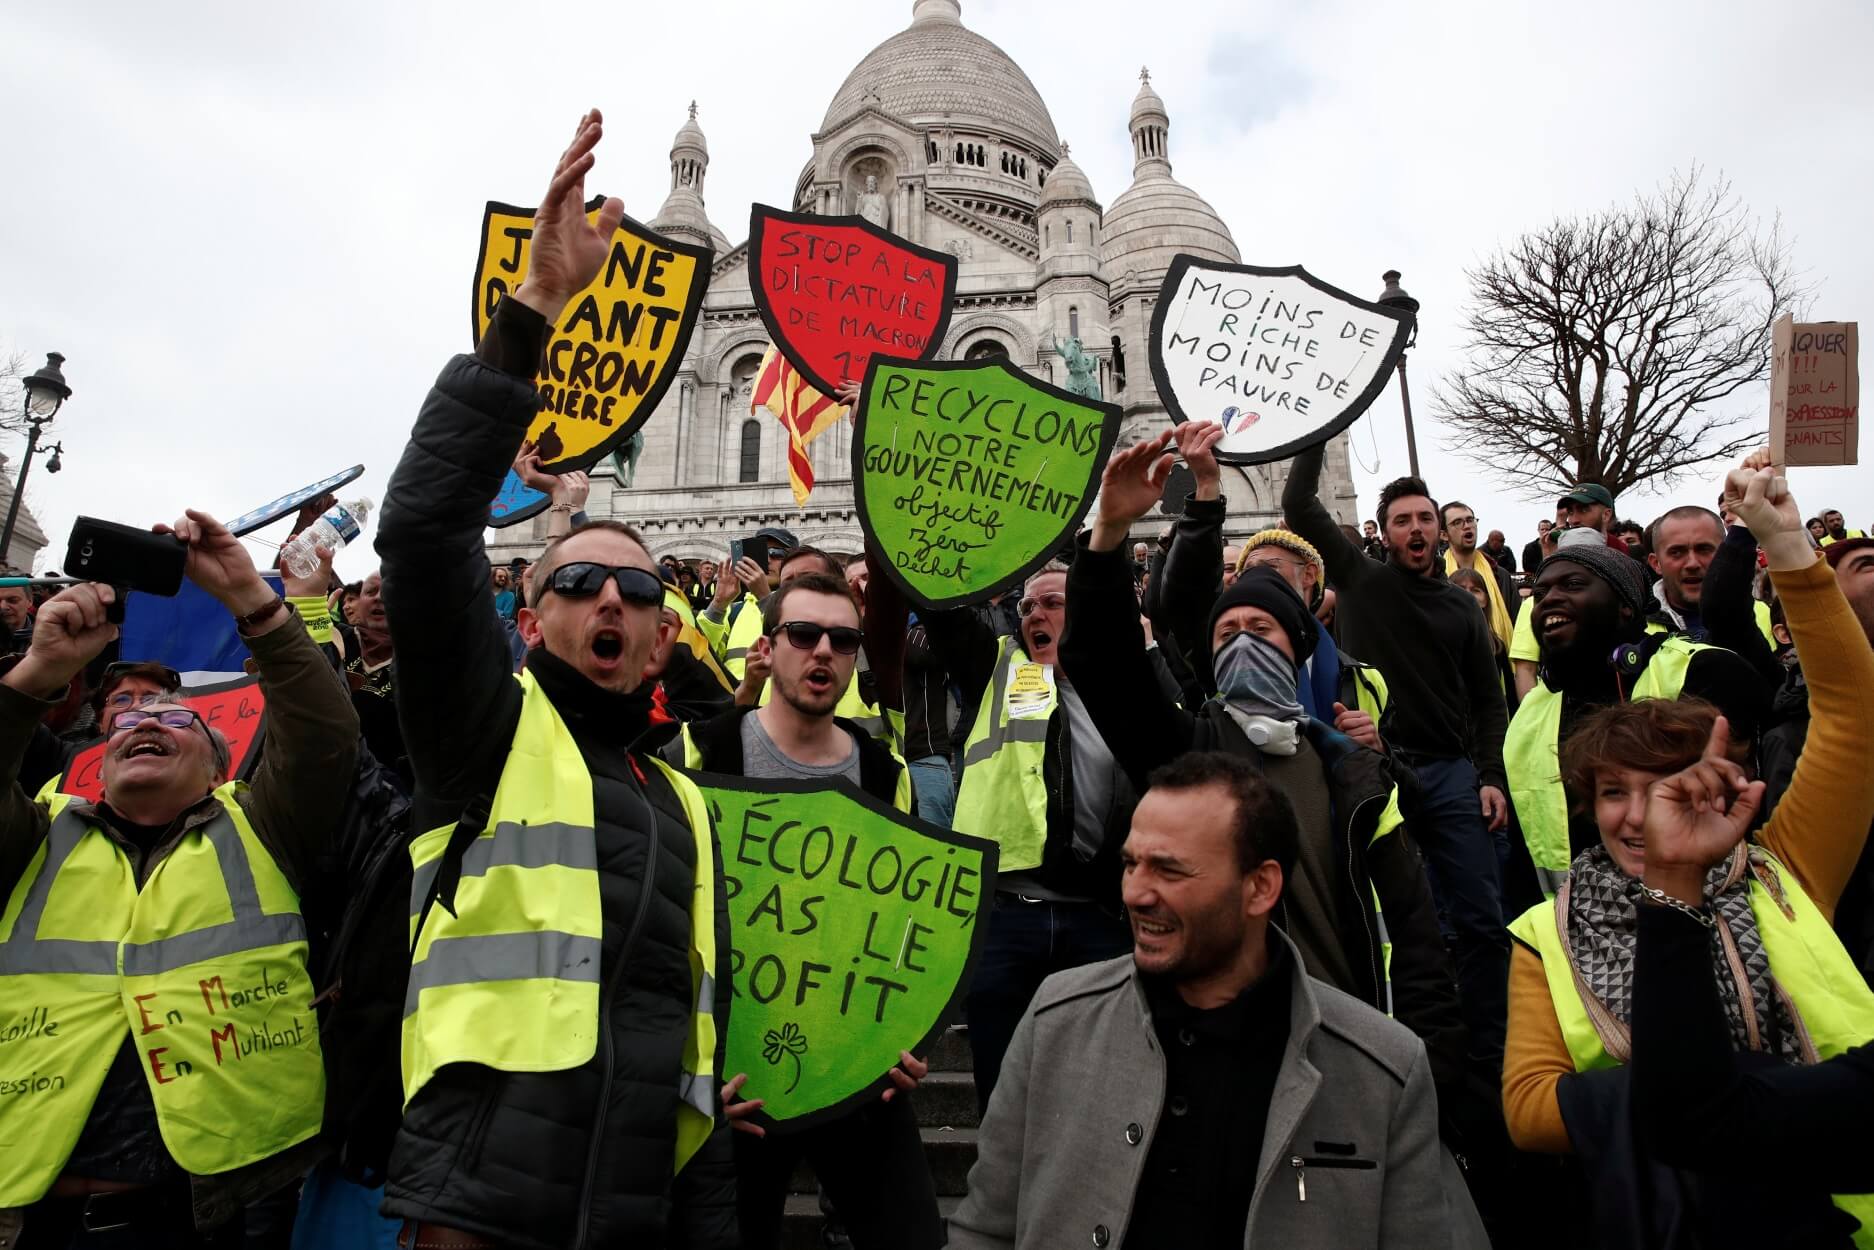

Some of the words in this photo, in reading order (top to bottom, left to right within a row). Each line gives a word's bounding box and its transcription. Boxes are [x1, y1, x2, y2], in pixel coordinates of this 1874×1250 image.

[499, 227, 675, 297] JNE
[777, 231, 862, 266] STOP
[872, 251, 890, 276] A
[904, 258, 936, 289] LA
[788, 307, 821, 332] DE
[840, 315, 928, 350] MACRON
[1340, 321, 1380, 347] DE
[1199, 367, 1311, 416] PAUVRE
[1316, 372, 1350, 400] DE
[1819, 380, 1838, 394] LA
[881, 374, 1104, 457] RECYCLONS
[913, 430, 1021, 468] NOTRE
[863, 445, 1080, 520] GOUVERNEMENT
[894, 485, 1004, 540] objectif
[863, 911, 934, 973] LE
[133, 992, 184, 1036] En
[199, 967, 289, 1016] Marche
[148, 1047, 193, 1085] En
[210, 1017, 304, 1067] Mutilant
